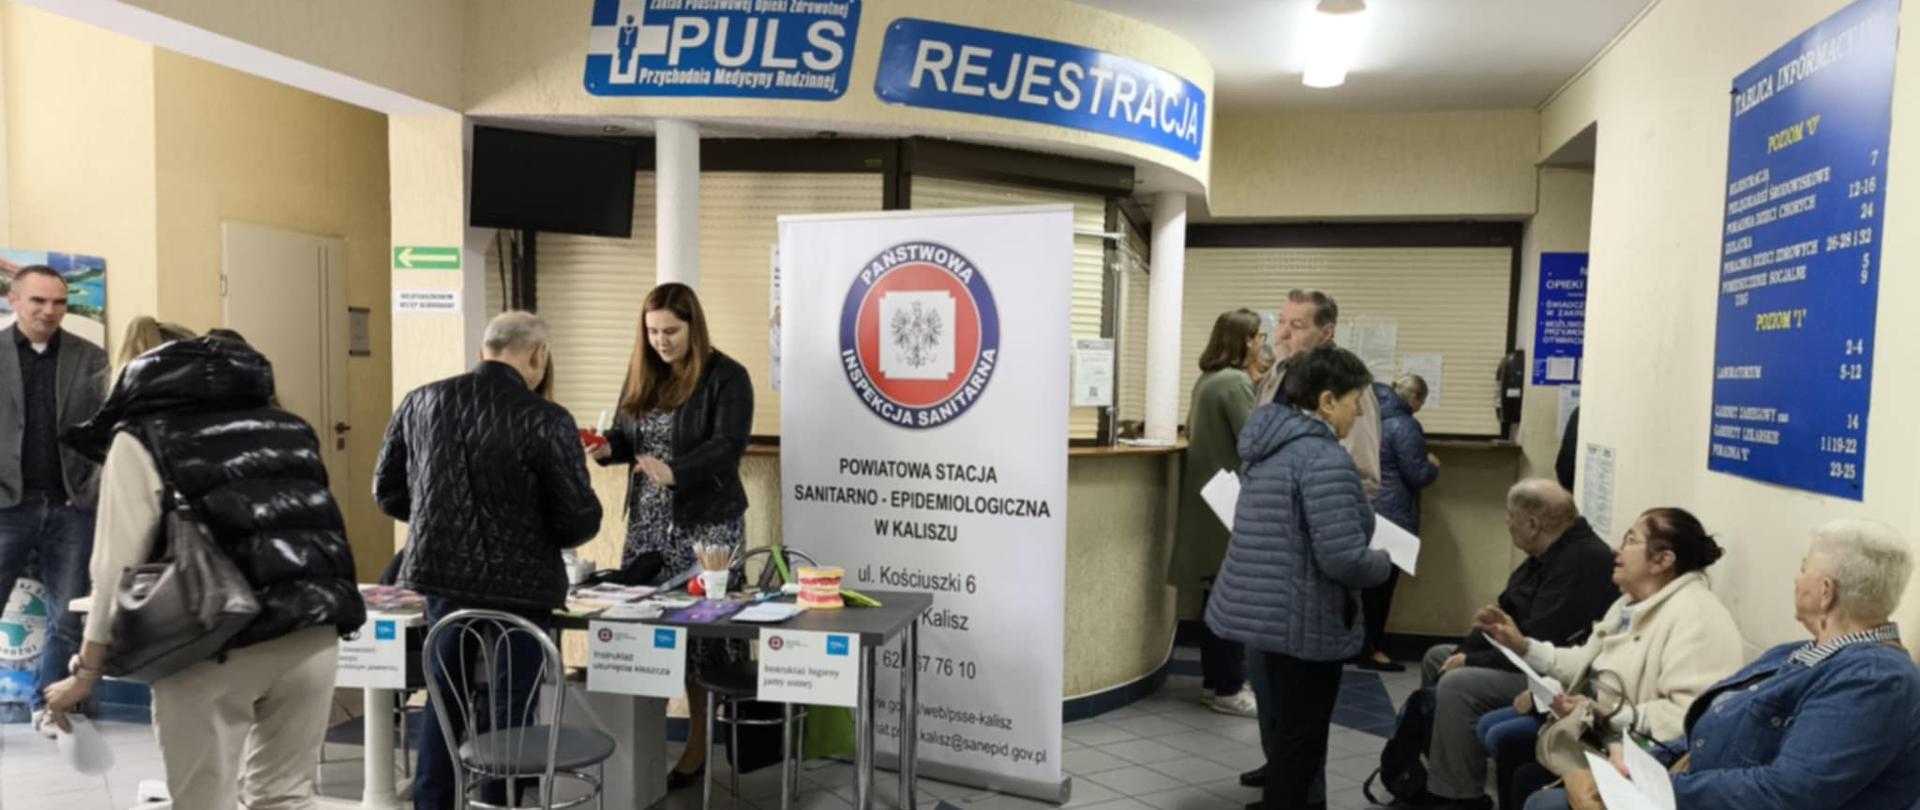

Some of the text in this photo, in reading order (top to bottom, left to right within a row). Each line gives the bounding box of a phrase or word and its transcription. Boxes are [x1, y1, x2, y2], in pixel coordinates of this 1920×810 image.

[755, 0, 787, 14] Opieki
[790, 0, 850, 18] Zdrowotnej
[668, 16, 845, 71] PULS
[638, 68, 836, 92] Przychodnia Medycyny Rodzinnej
[909, 38, 1198, 145] REJESTRACJA
[1735, 75, 1774, 118] TABLICA
[1768, 121, 1804, 153] POZIOM
[1871, 150, 1879, 166] 7
[1849, 176, 1876, 198] 12-16
[1779, 194, 1816, 218] CHORYCH
[1860, 202, 1874, 219] 24
[1769, 264, 1807, 285] SOCJALNE
[1862, 252, 1870, 269] 5
[1860, 269, 1868, 285] 9
[1756, 311, 1791, 331] POZIOM
[1845, 339, 1863, 355] 2-4
[1840, 363, 1862, 380] 5-12
[842, 349, 914, 425] INSPEKCJA
[917, 349, 996, 427] SANITARNA
[1847, 413, 1859, 429] 14
[840, 458, 998, 484] POWIATOWA STACJA
[1830, 461, 1856, 479] 23-25
[794, 484, 878, 506] SANITARNO
[891, 490, 1051, 518] EPIDEMIOLOGICZNA
[874, 519, 957, 542] W KALISZU
[858, 565, 977, 594] ul. Kościuszki 6
[922, 608, 969, 631] Kalisz
[883, 650, 900, 669] 62
[935, 657, 954, 677] 76
[959, 661, 977, 680] 10
